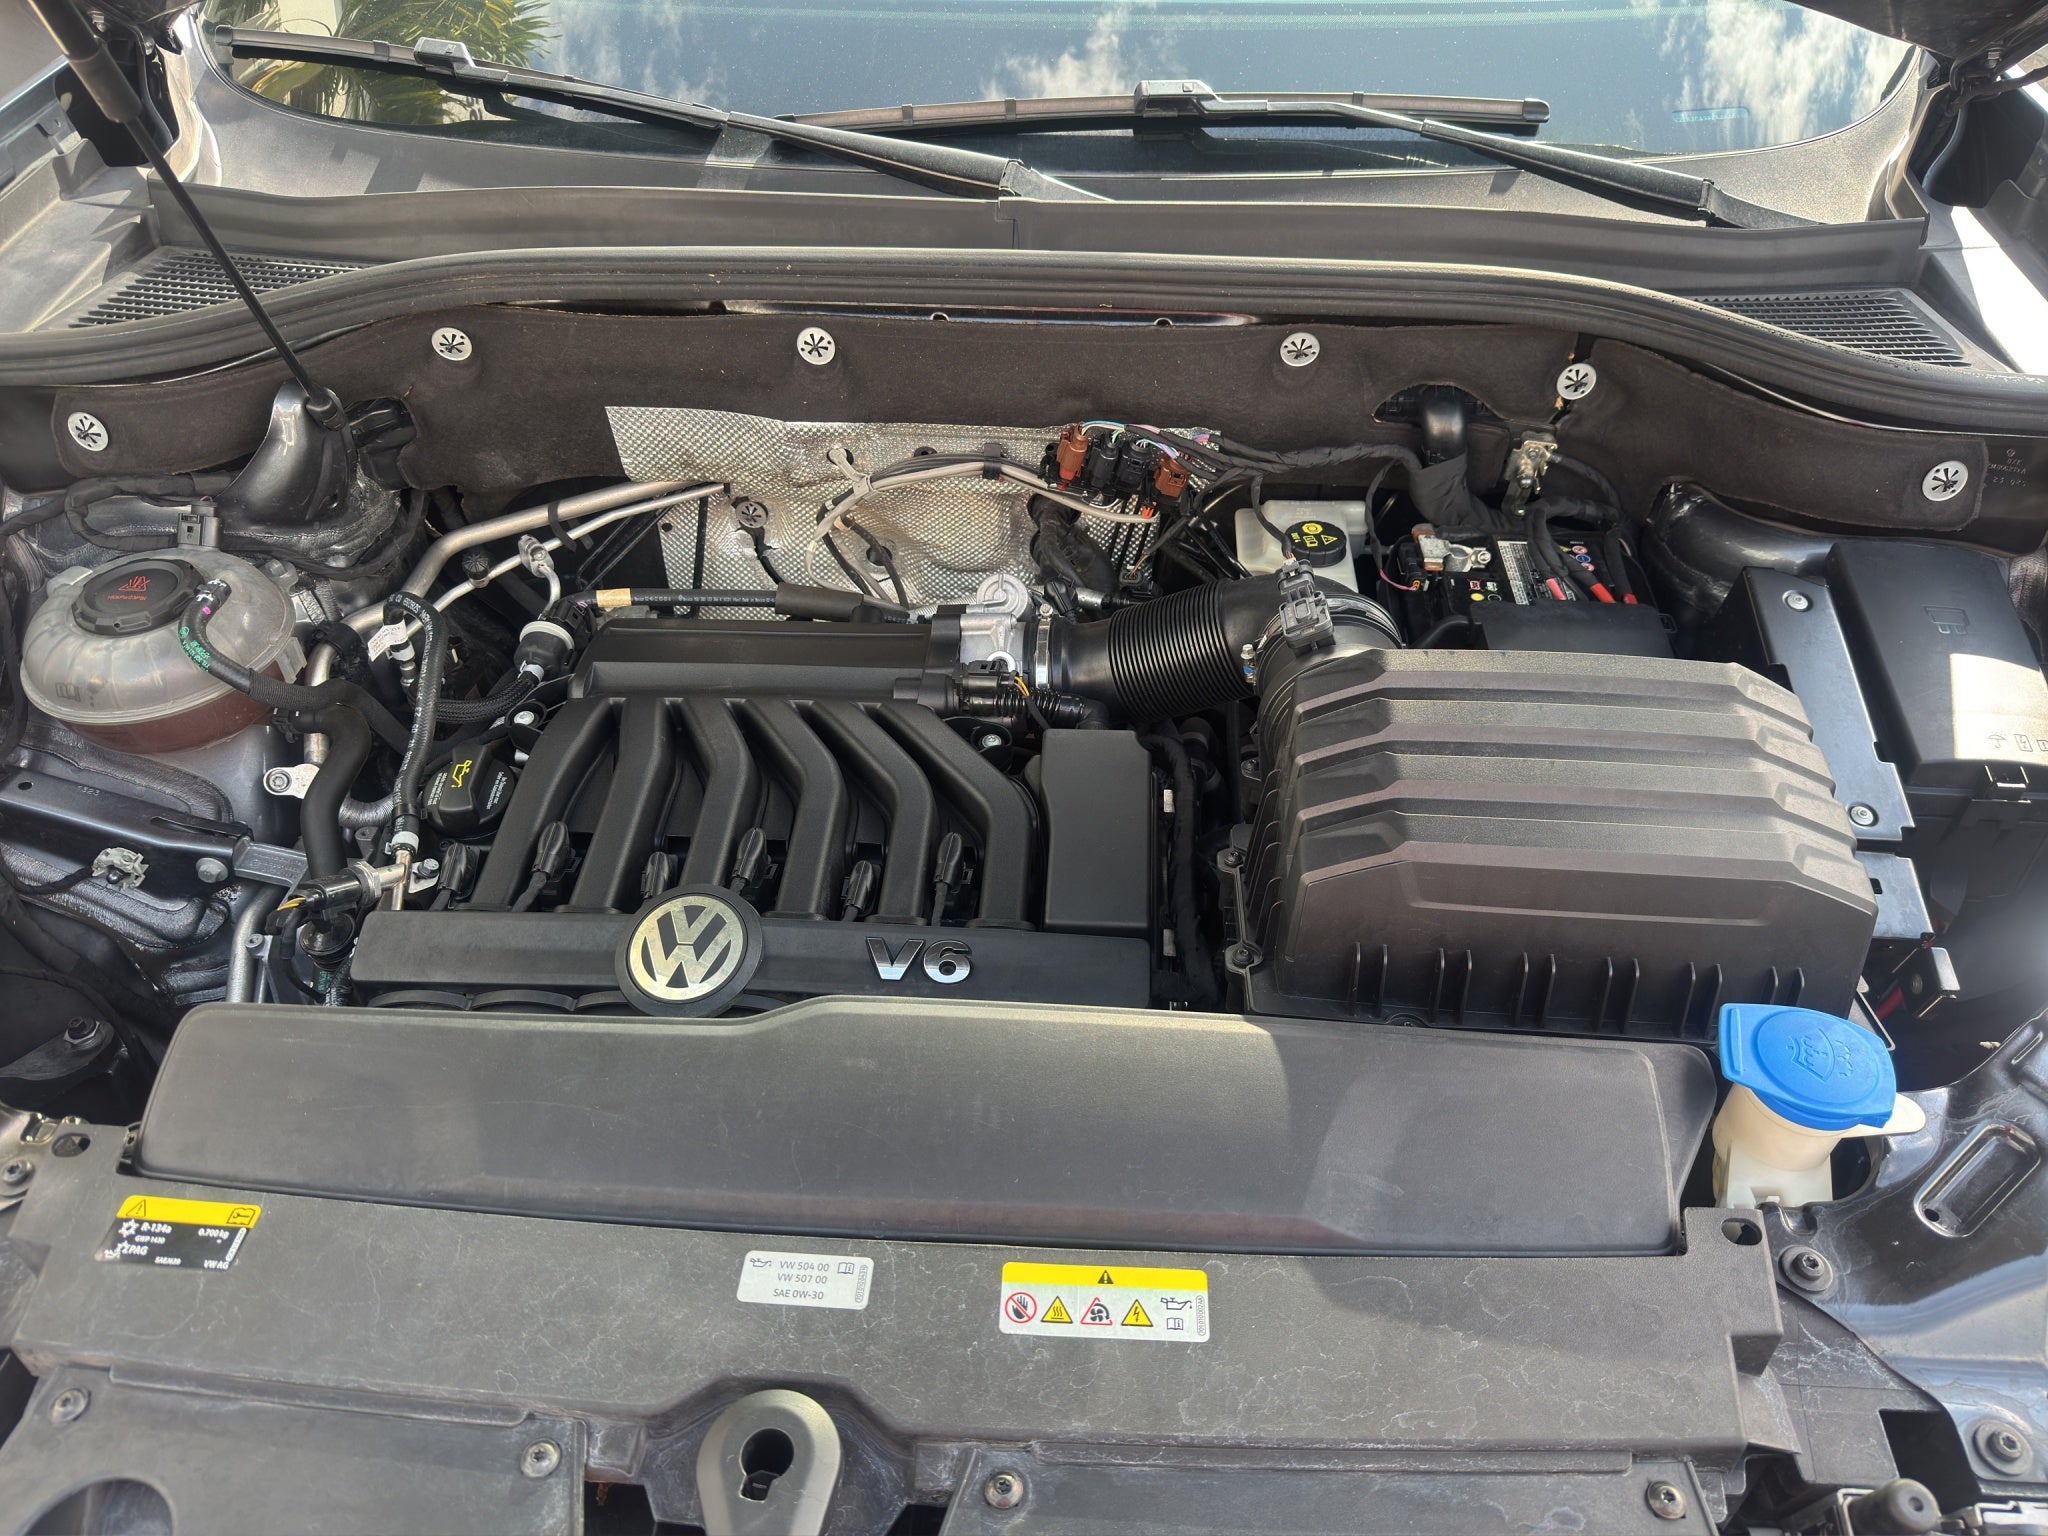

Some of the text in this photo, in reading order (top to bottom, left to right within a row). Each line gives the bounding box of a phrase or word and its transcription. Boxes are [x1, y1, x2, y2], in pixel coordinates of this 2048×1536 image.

[865, 936, 973, 984] V6
[141, 1222, 172, 1234] R-134a
[780, 1260, 830, 1272] VW 504 00
[777, 1272, 828, 1284] VW 507 00
[773, 1288, 824, 1300] SAE 0W-30
